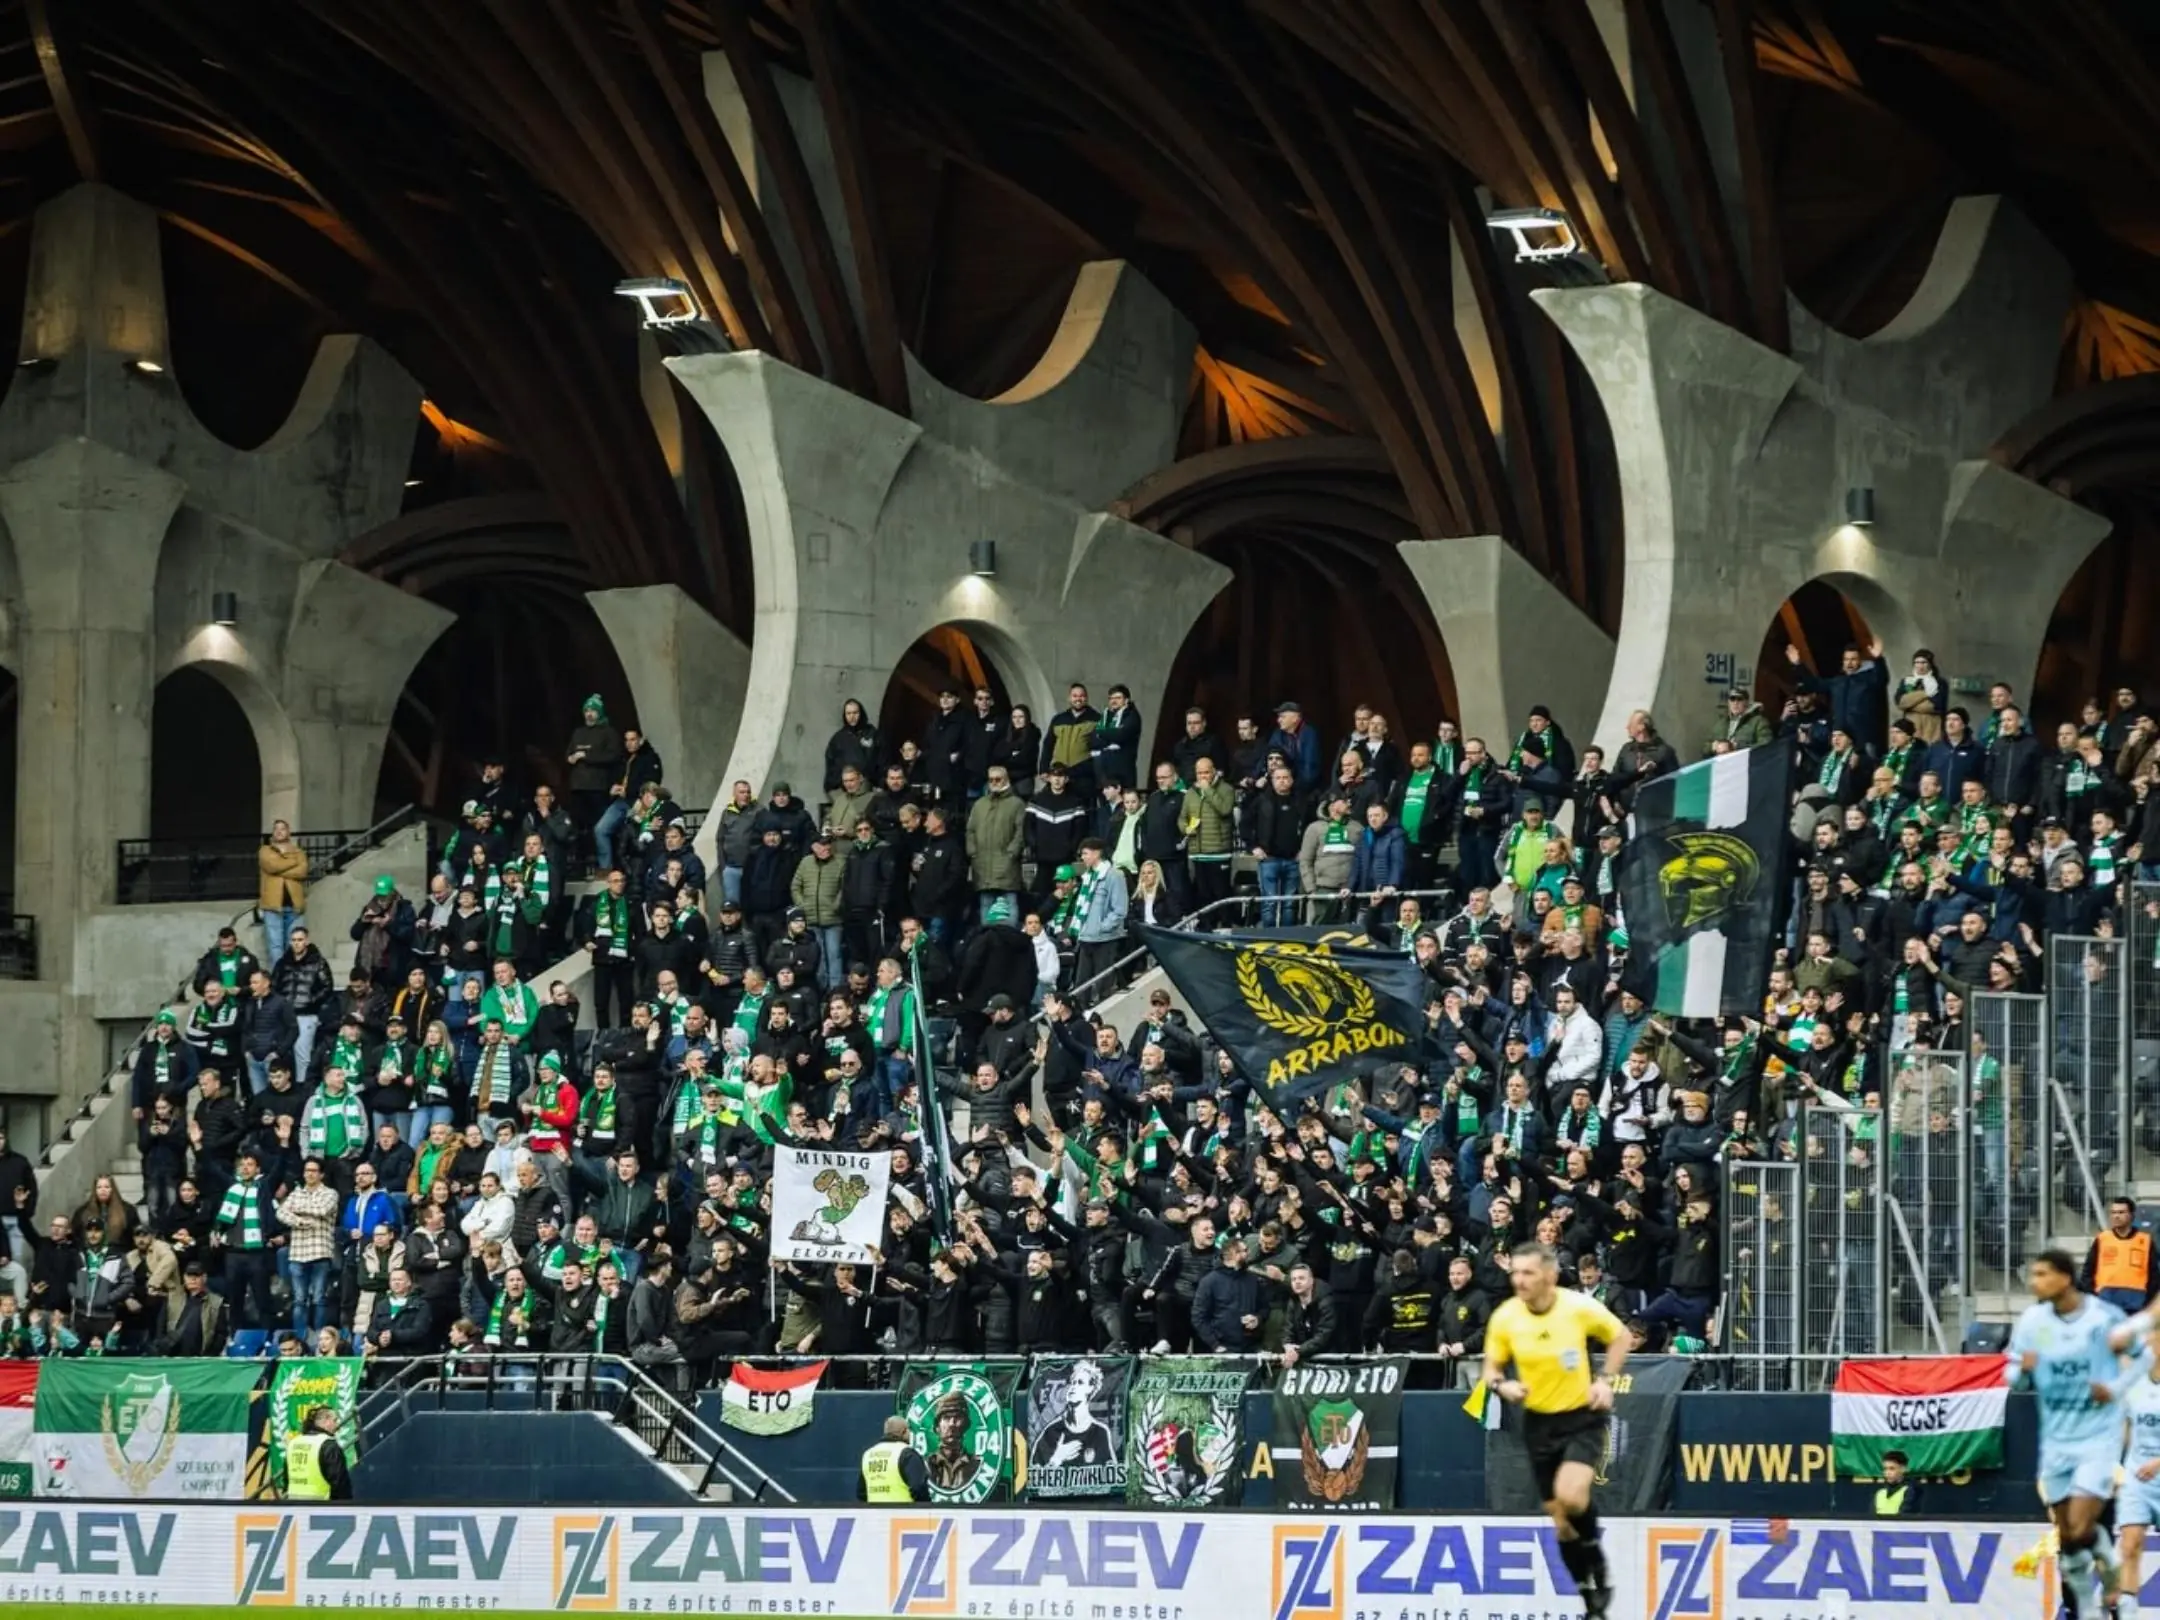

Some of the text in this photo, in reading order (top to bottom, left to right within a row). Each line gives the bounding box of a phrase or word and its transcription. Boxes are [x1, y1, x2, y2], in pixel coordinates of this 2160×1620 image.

[1706, 653, 1728, 673] 3H
[796, 1151, 871, 1170] MINDIG
[1354, 1365, 1399, 1394] ETO
[748, 1390, 791, 1414] ETO
[1886, 1399, 1950, 1432] GECSE
[306, 1515, 518, 1580] ZAEV
[629, 1516, 856, 1584] ZAEV
[968, 1518, 1205, 1590] ZAEV
[1356, 1525, 1605, 1596] ZAEV
[1736, 1529, 2003, 1604] ZAEV
[80, 1588, 158, 1603] mester
[306, 1593, 327, 1607] az
[417, 1595, 499, 1609] mester
[629, 1597, 651, 1610] az
[750, 1597, 836, 1614] mester
[967, 1601, 991, 1615] az
[1092, 1604, 1183, 1619] mester
